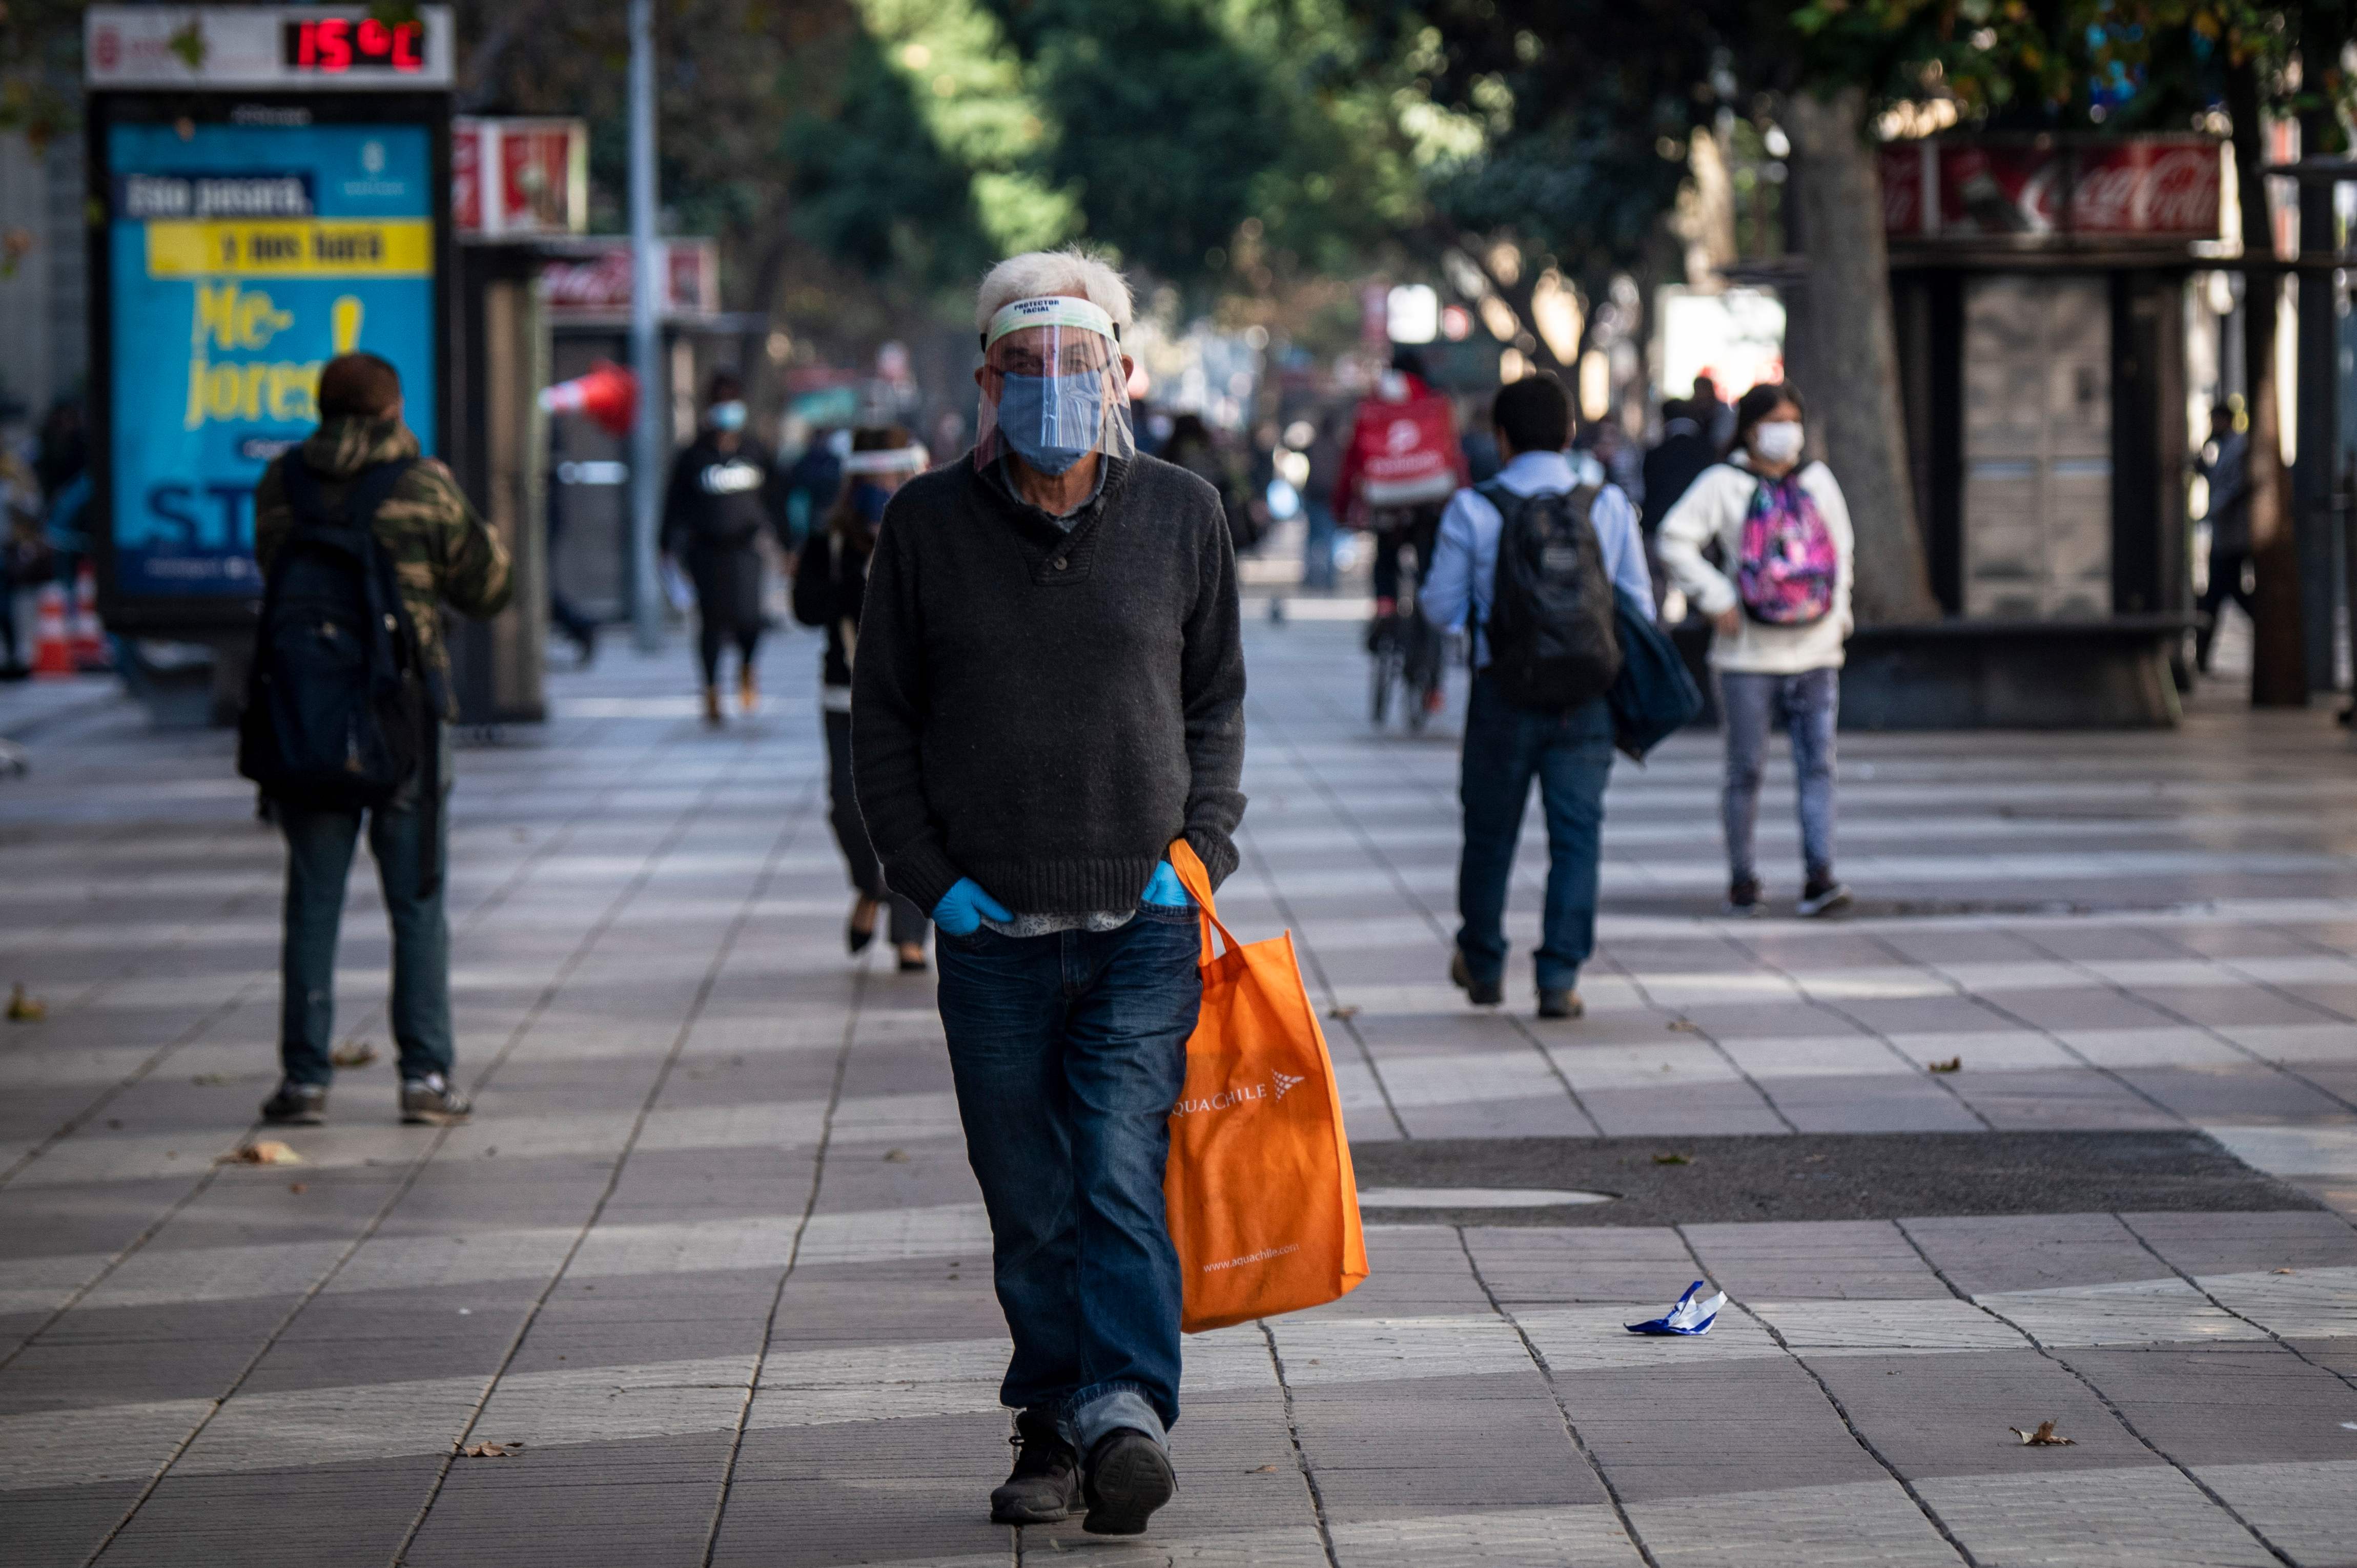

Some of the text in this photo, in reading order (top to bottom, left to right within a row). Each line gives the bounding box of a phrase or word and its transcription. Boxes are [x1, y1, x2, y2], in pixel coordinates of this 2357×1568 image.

[1014, 300, 1059, 311] PROTECTOR
[1023, 306, 1049, 315] FACIAL
[1172, 1083, 1266, 1117] QUACHILE
[1203, 1243, 1300, 1272] www.aquachile.com
